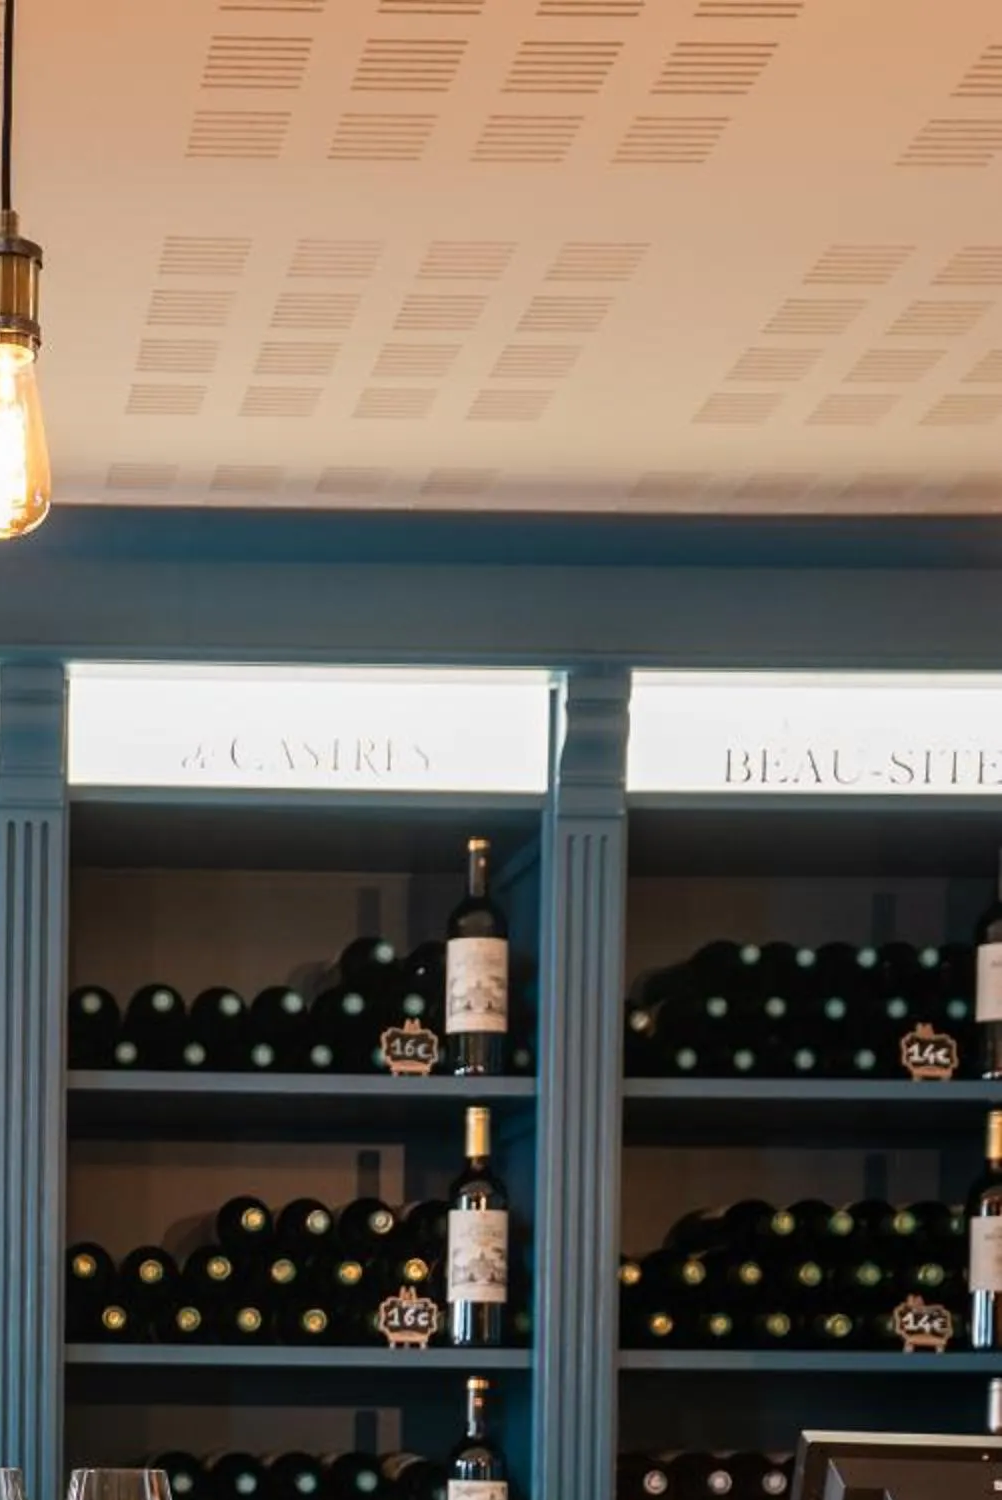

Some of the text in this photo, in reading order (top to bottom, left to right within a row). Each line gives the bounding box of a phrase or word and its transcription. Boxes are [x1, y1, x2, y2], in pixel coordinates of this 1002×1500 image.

[389, 1036, 430, 1060] 16€
[908, 1044, 950, 1066] 14€
[387, 1307, 429, 1328] 16€
